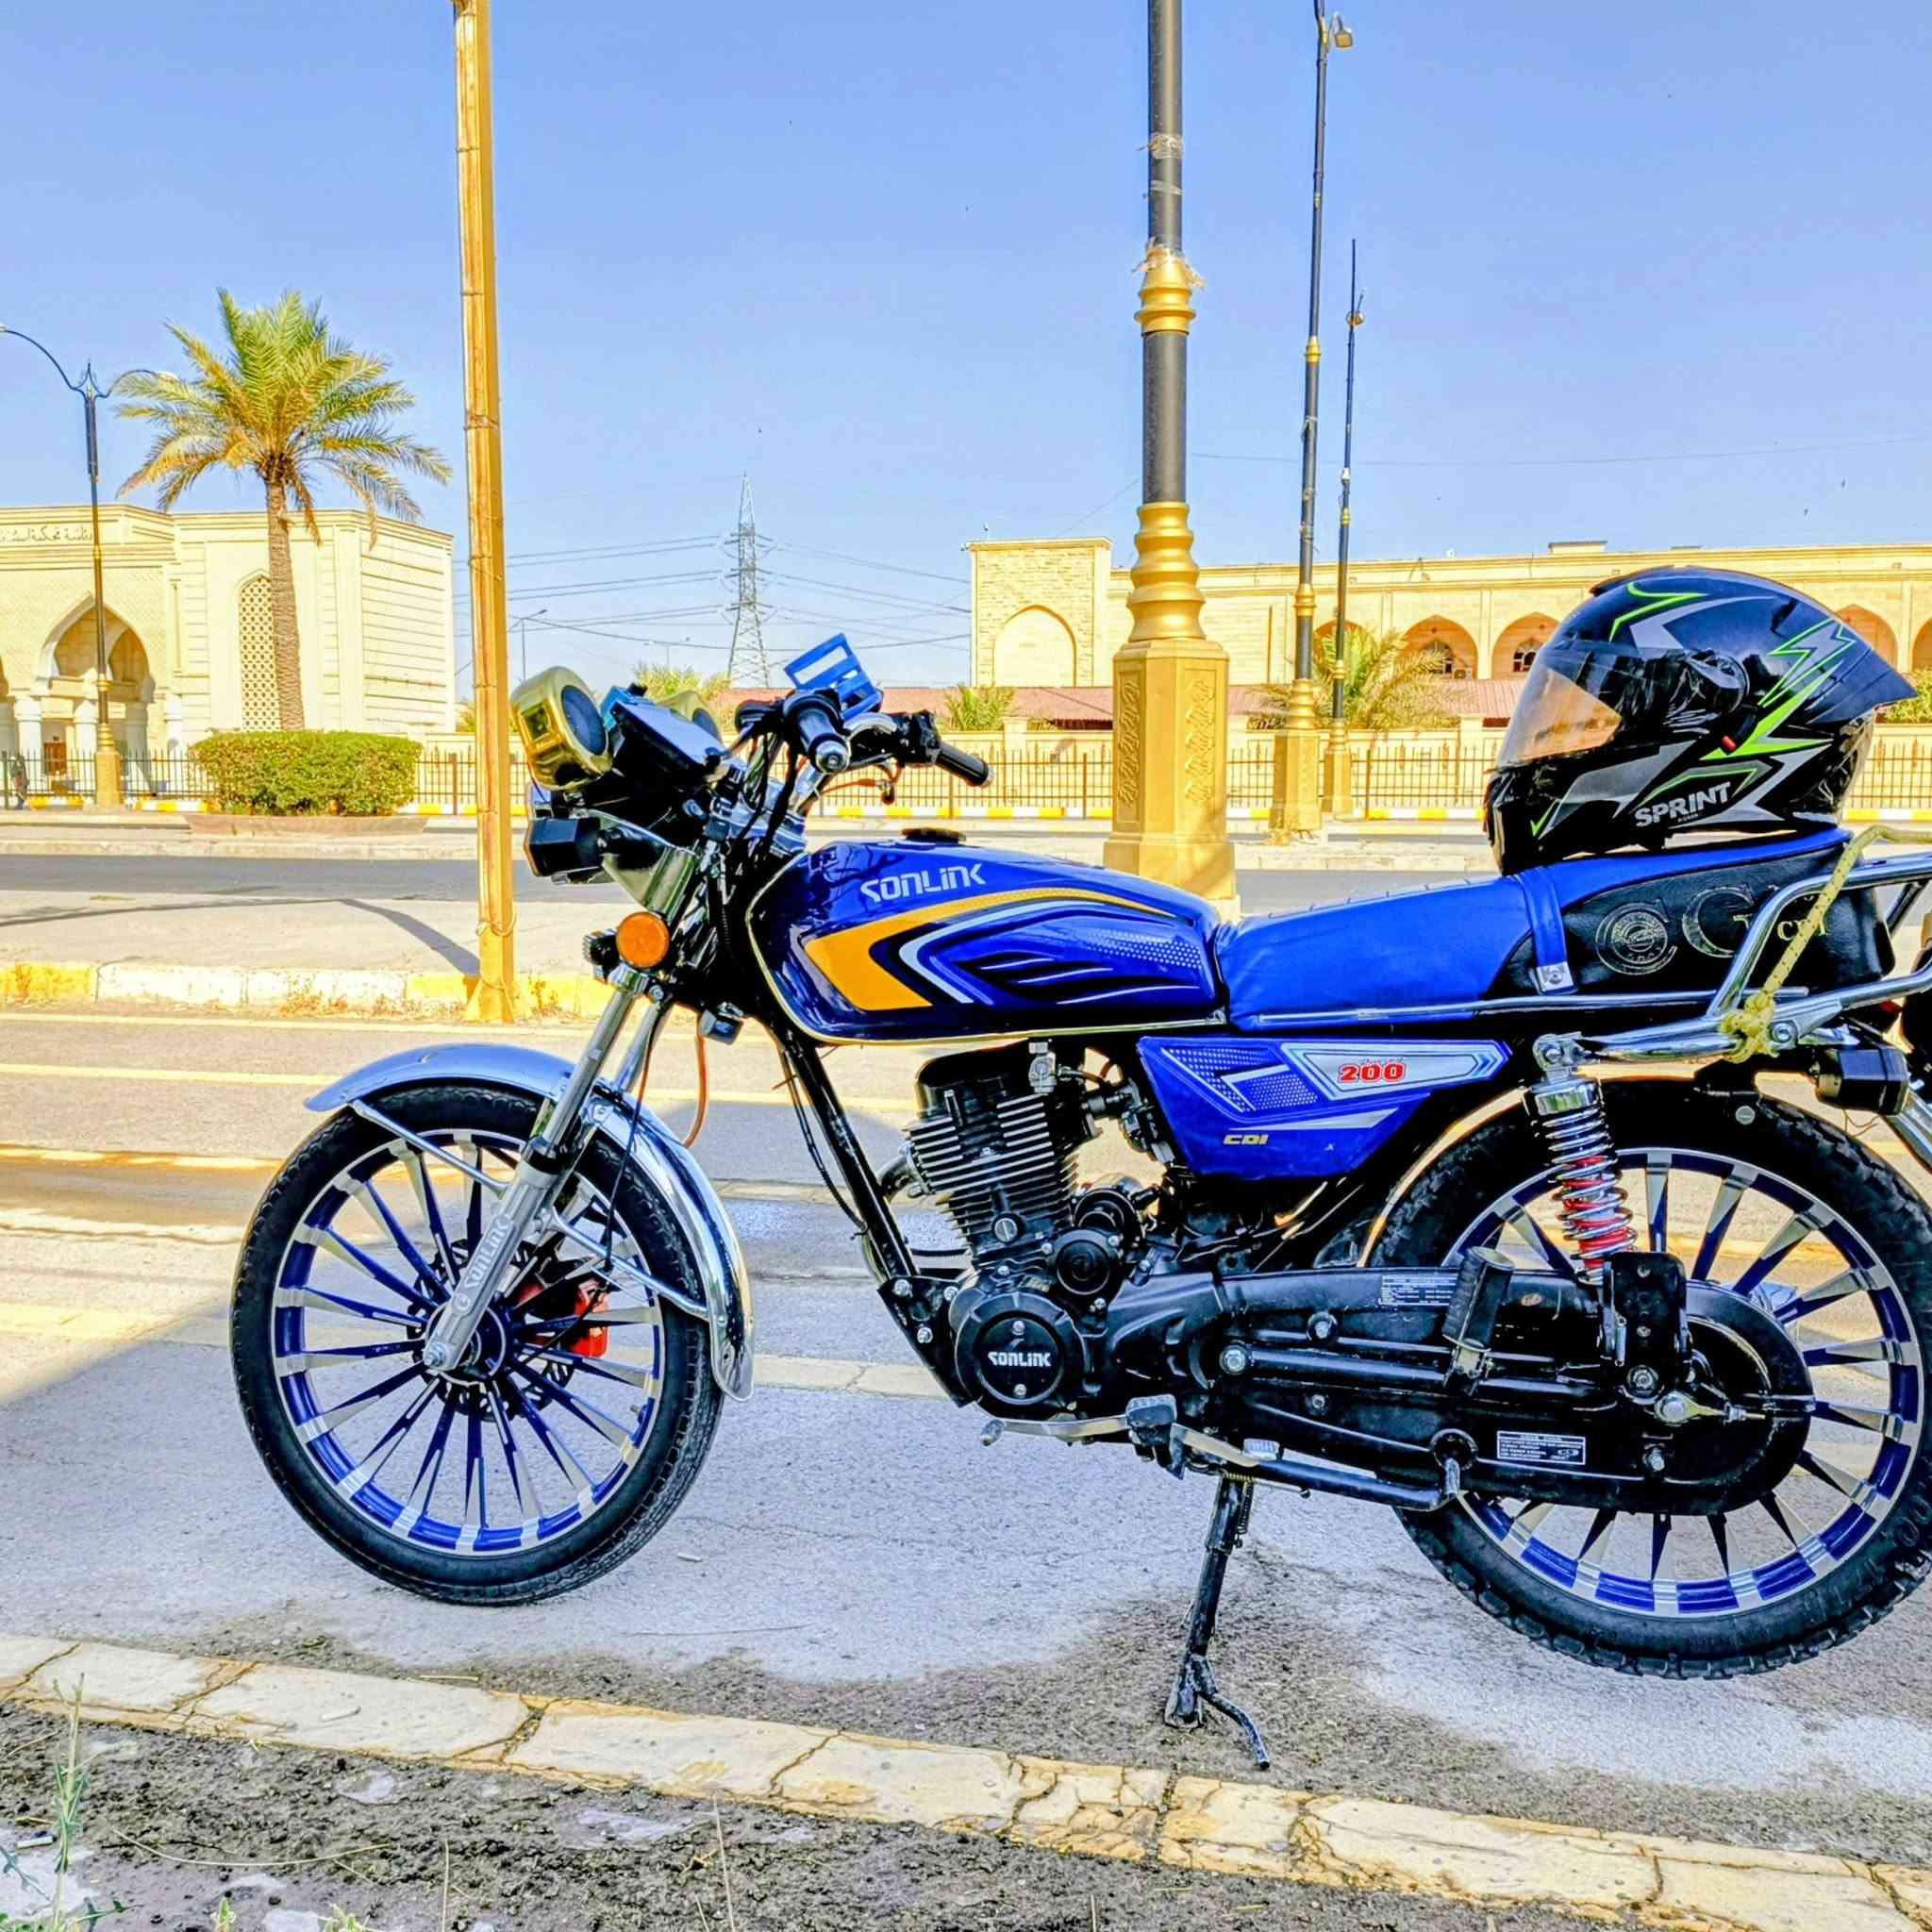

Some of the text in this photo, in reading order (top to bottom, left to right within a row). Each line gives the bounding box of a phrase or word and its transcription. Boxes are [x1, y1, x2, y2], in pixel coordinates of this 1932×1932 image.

[1634, 781, 1731, 826] SPRINT
[1338, 1063, 1405, 1083] 200
[1223, 1134, 1269, 1146] CDI
